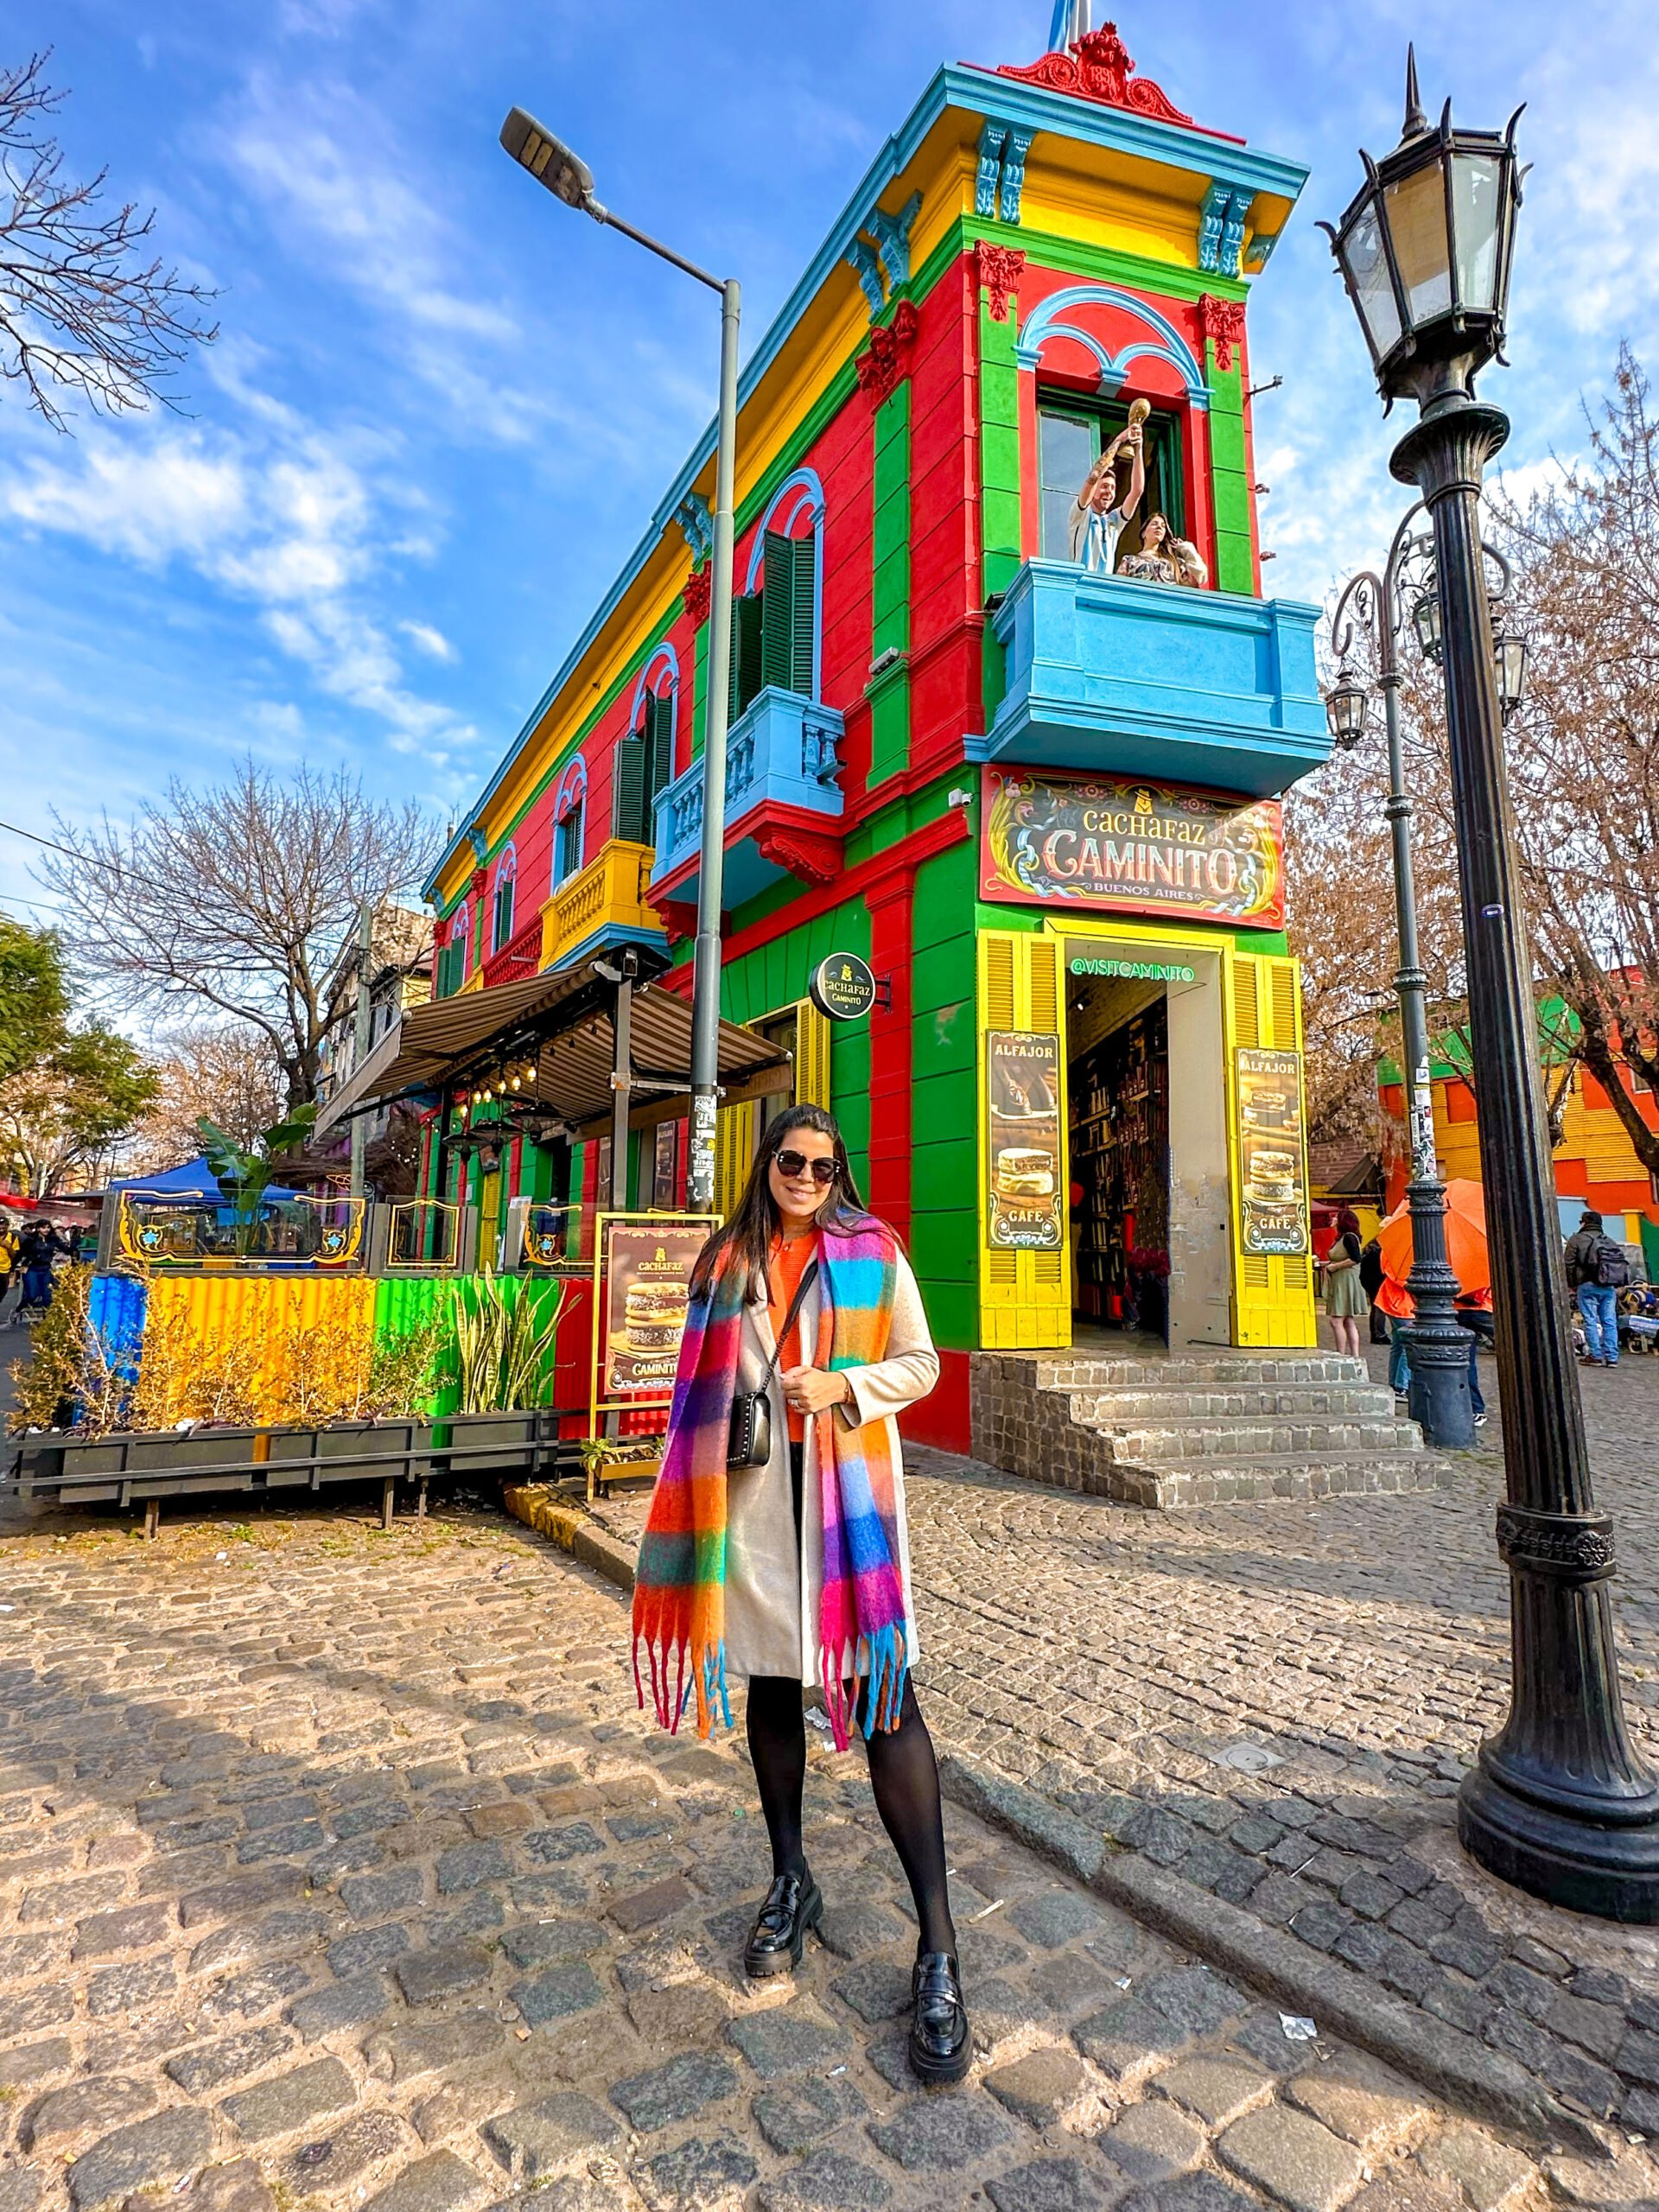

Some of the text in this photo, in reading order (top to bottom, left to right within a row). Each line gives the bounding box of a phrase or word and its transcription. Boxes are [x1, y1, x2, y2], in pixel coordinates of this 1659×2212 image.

[1042, 830, 1237, 896] CAMINITO
[1093, 883, 1194, 901] BUENOS AIRES
[1071, 958, 1194, 982] @VISITCAMINITO
[832, 994, 861, 1005] CAMINITO
[995, 1044, 1053, 1058] ALFAJOR
[1244, 1061, 1295, 1074] ALFAJOR
[1008, 1210, 1044, 1223] CAFE
[1260, 1217, 1291, 1230] CAFE
